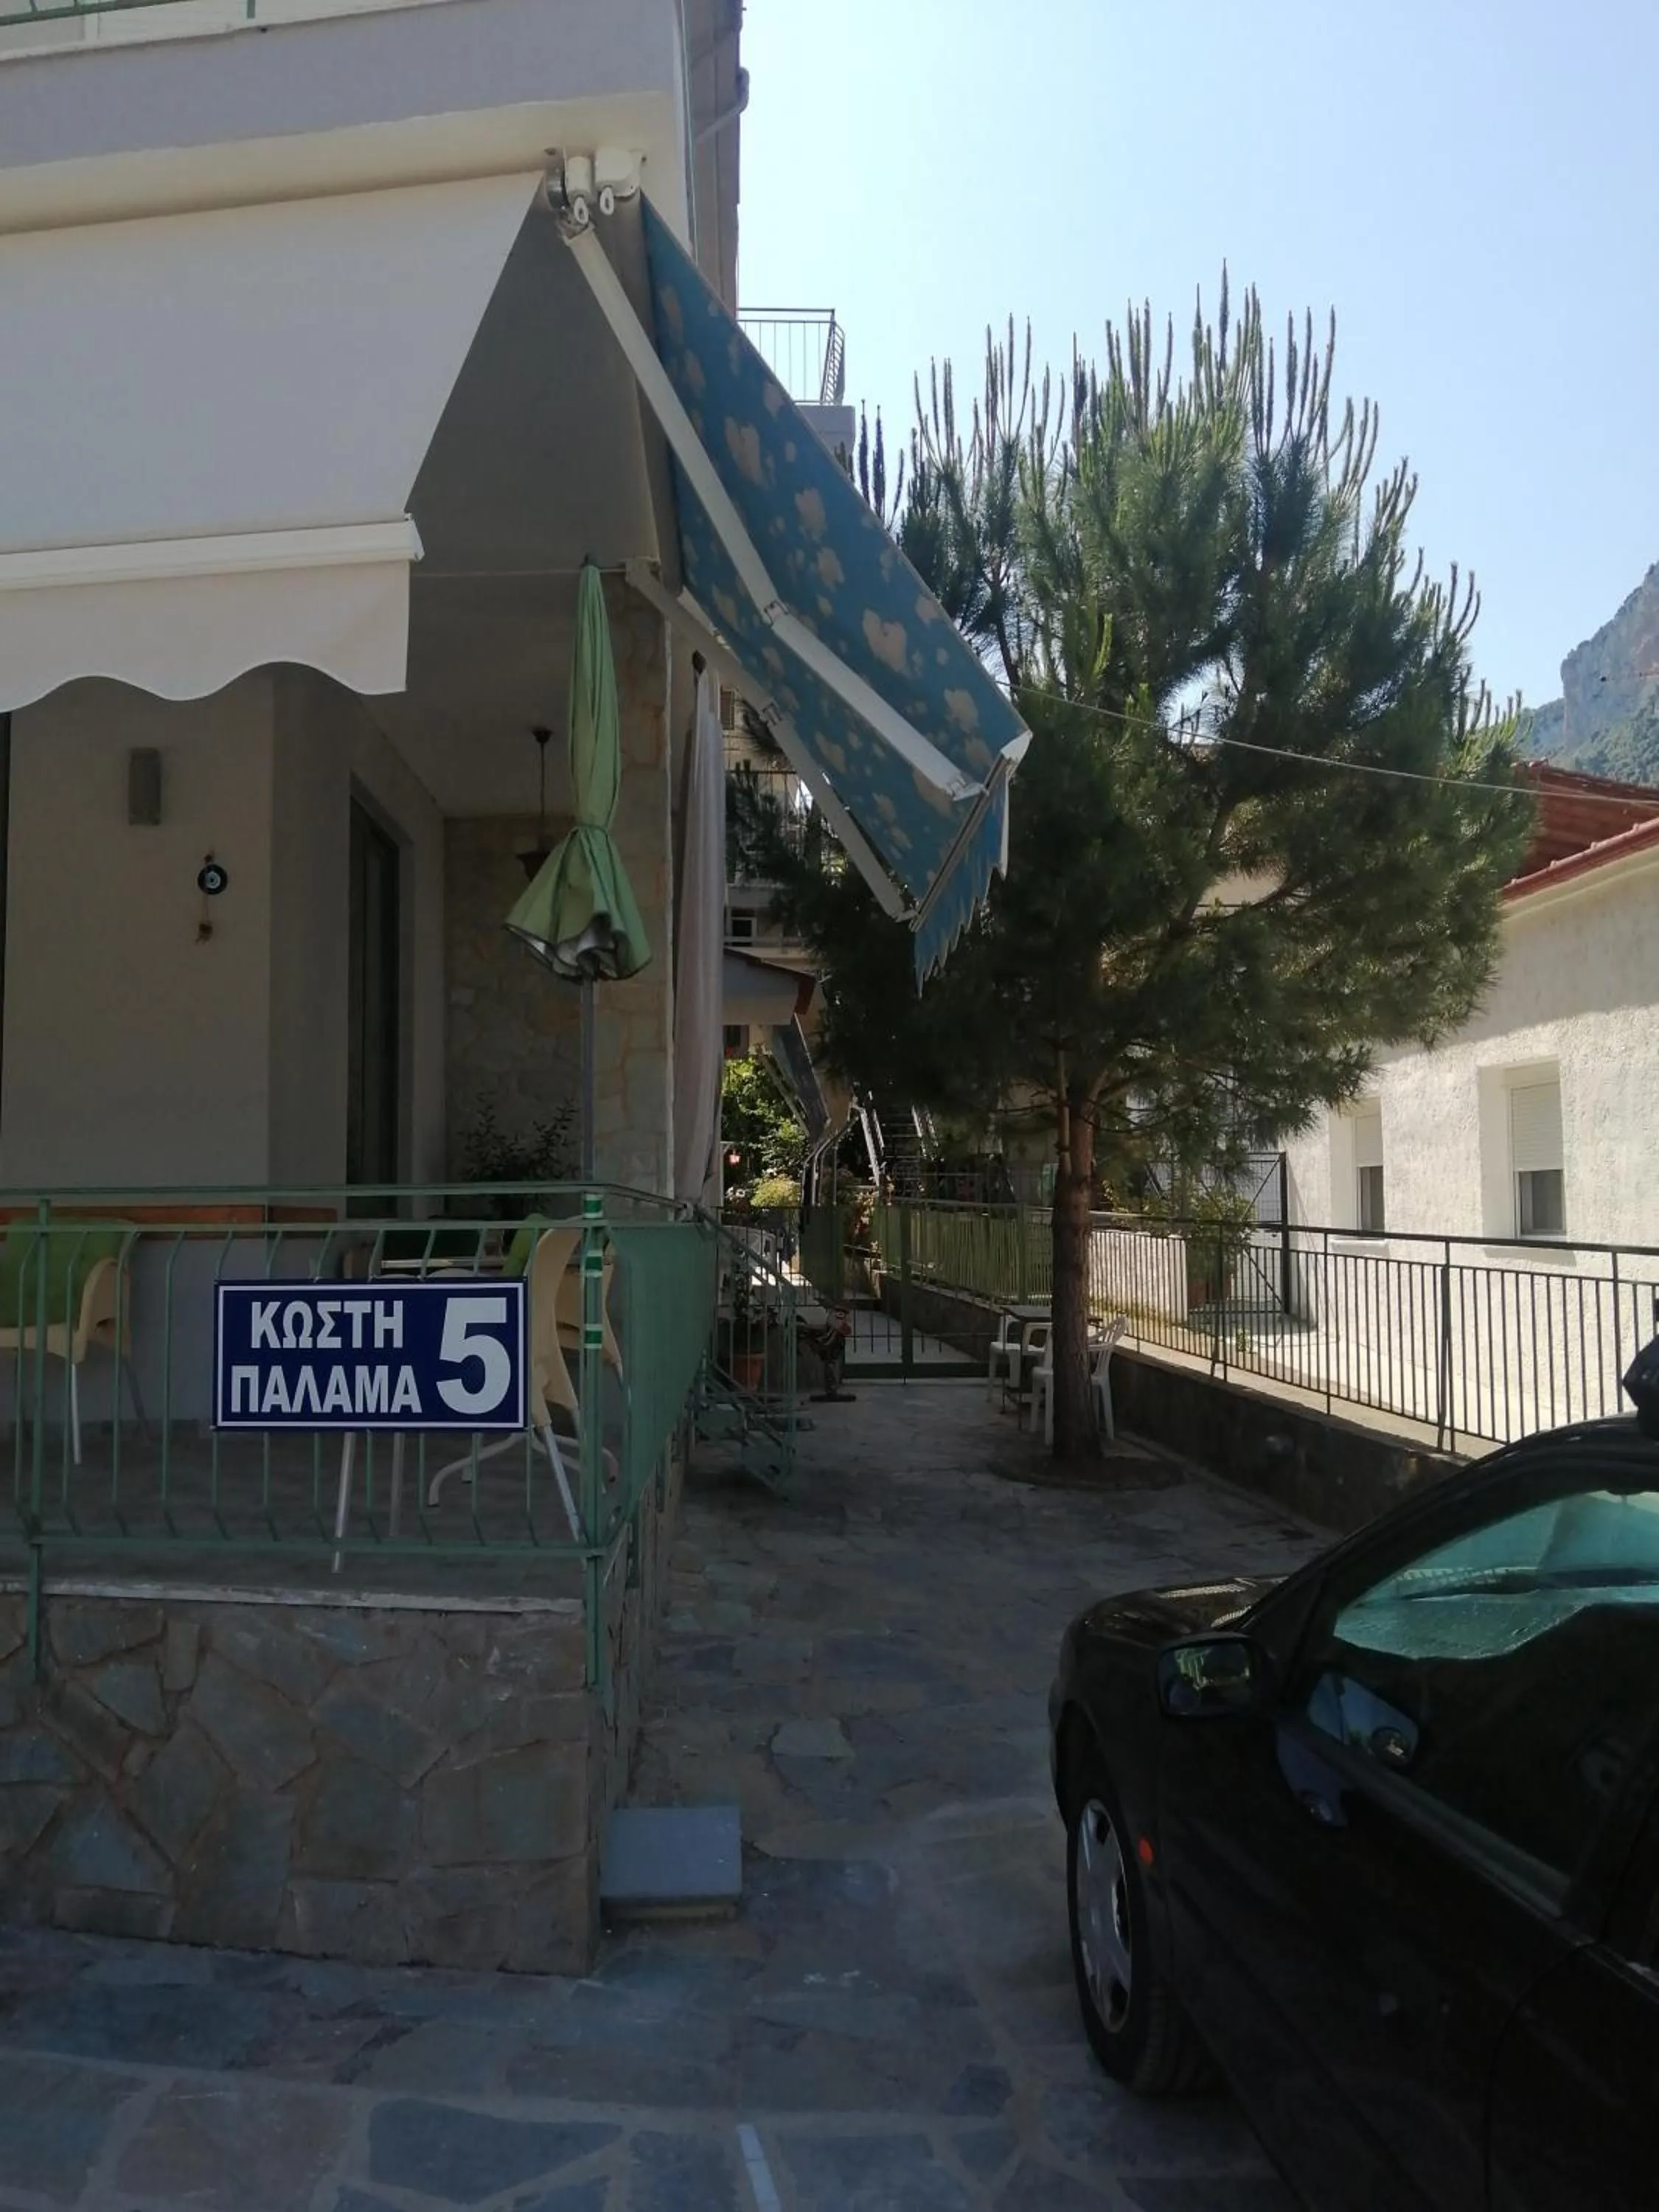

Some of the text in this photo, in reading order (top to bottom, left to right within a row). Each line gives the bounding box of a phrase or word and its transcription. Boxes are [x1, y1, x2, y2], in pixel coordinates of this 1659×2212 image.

[251, 1300, 404, 1349] ΚΩΣΤΗ
[436, 1297, 511, 1415] 5
[230, 1365, 422, 1413] ΠΑΛΑΜΑ
